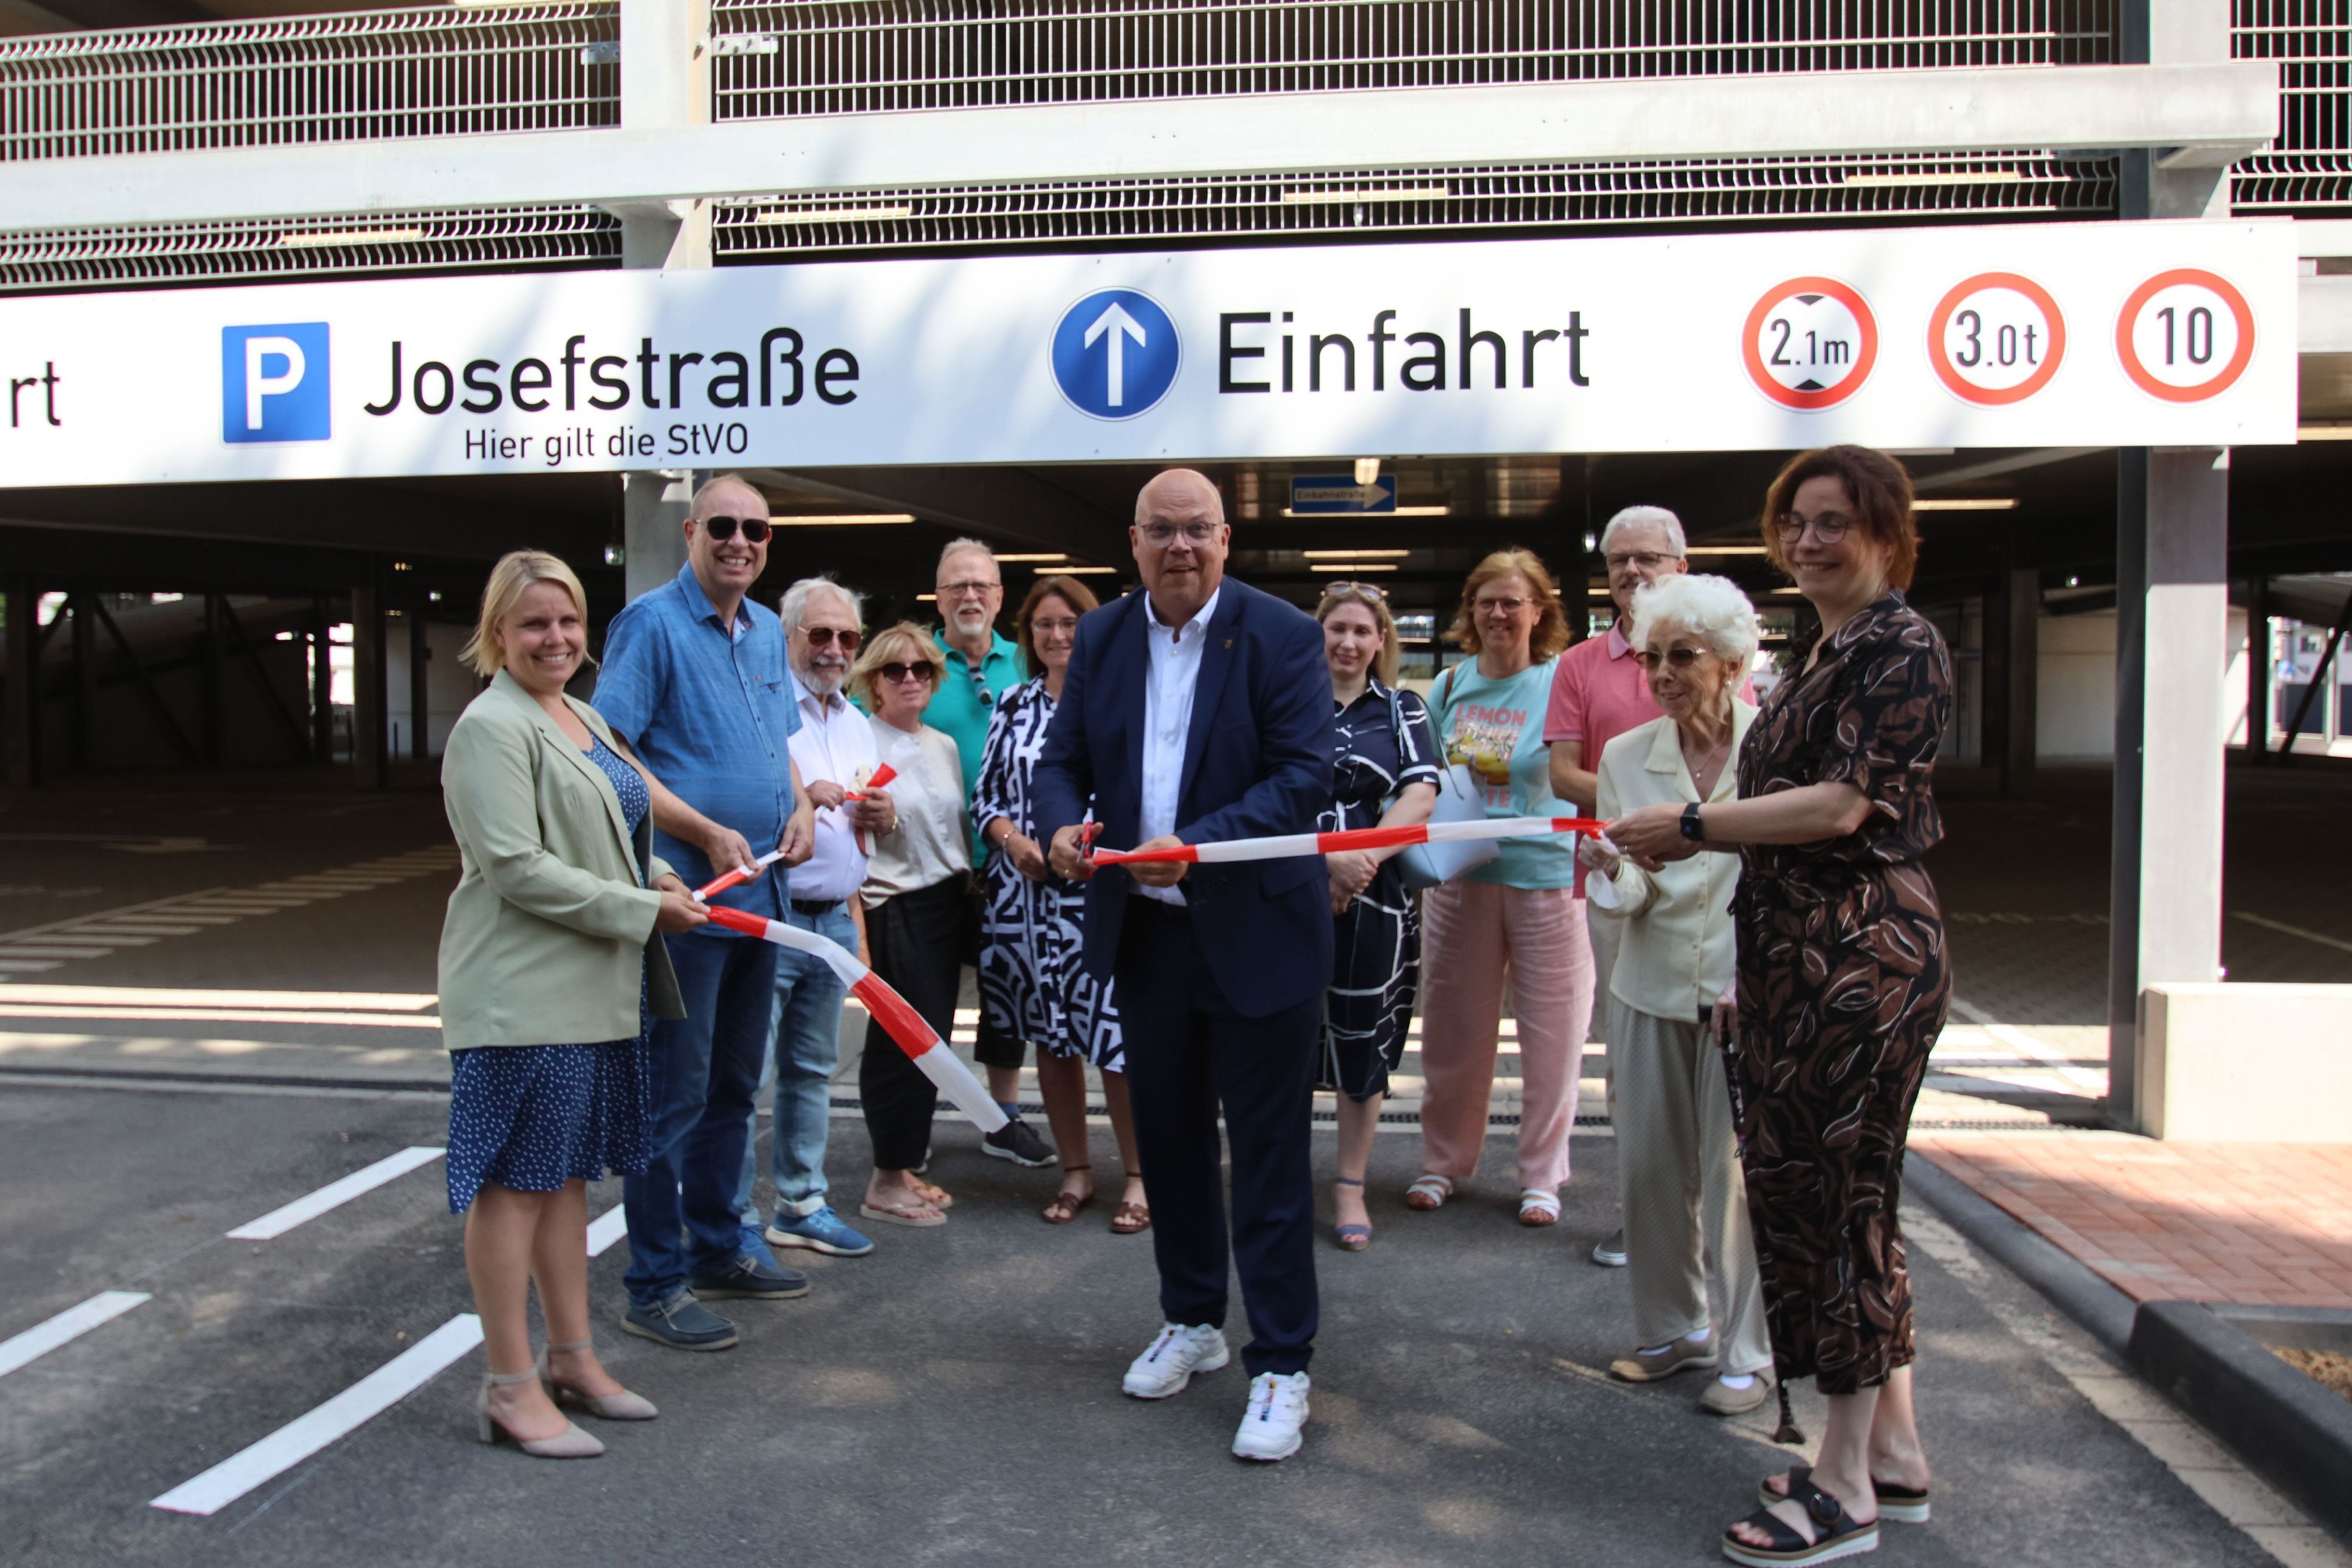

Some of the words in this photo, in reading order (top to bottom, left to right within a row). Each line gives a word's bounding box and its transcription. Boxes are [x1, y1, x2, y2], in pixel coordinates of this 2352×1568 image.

[1218, 307, 1590, 394] Einfahrt
[1770, 318, 1849, 366] 2.1m
[1957, 309, 2037, 367] 3.0t
[2158, 306, 2213, 365] 10
[245, 336, 306, 430] P
[364, 327, 860, 417] Josefstraße
[465, 428, 533, 460] Hier
[545, 427, 595, 466] gilt
[608, 424, 656, 457] die
[667, 422, 749, 456] StVO
[1456, 703, 1527, 726] LEMON
